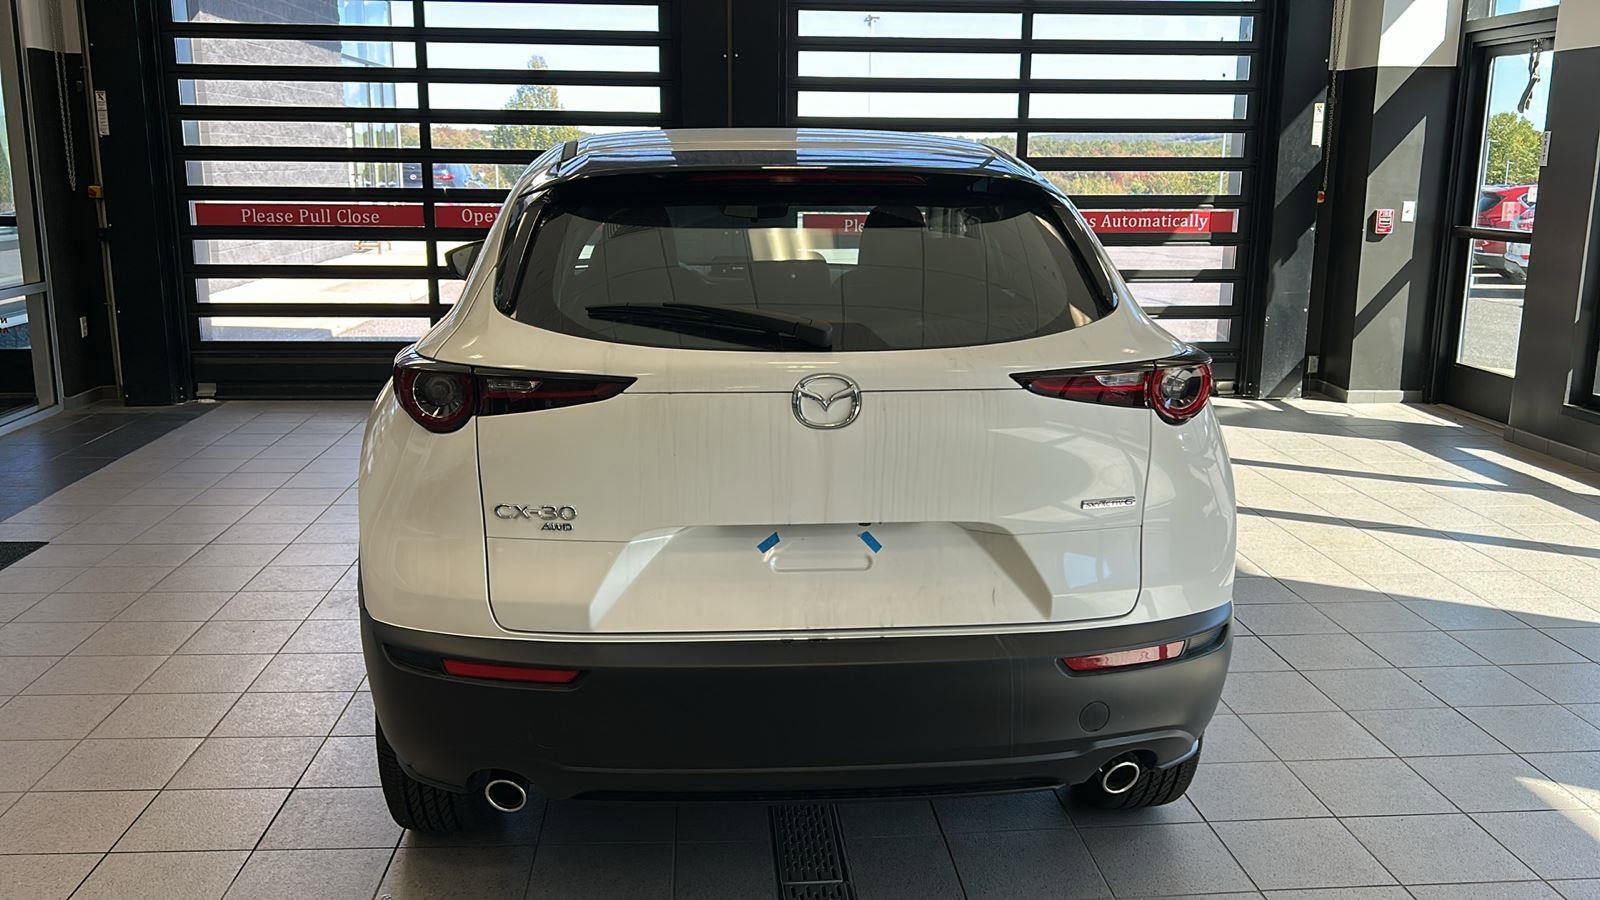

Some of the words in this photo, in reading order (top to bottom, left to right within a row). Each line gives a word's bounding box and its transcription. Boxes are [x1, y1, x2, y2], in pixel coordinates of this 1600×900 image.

[241, 208, 294, 224] Please
[299, 208, 332, 224] Pull
[336, 208, 380, 224] Close
[461, 208, 498, 226] Ope
[1100, 213, 1209, 231] Automatically
[843, 218, 866, 233] Ple
[494, 504, 577, 521] CX-30
[541, 522, 574, 531] AWD
